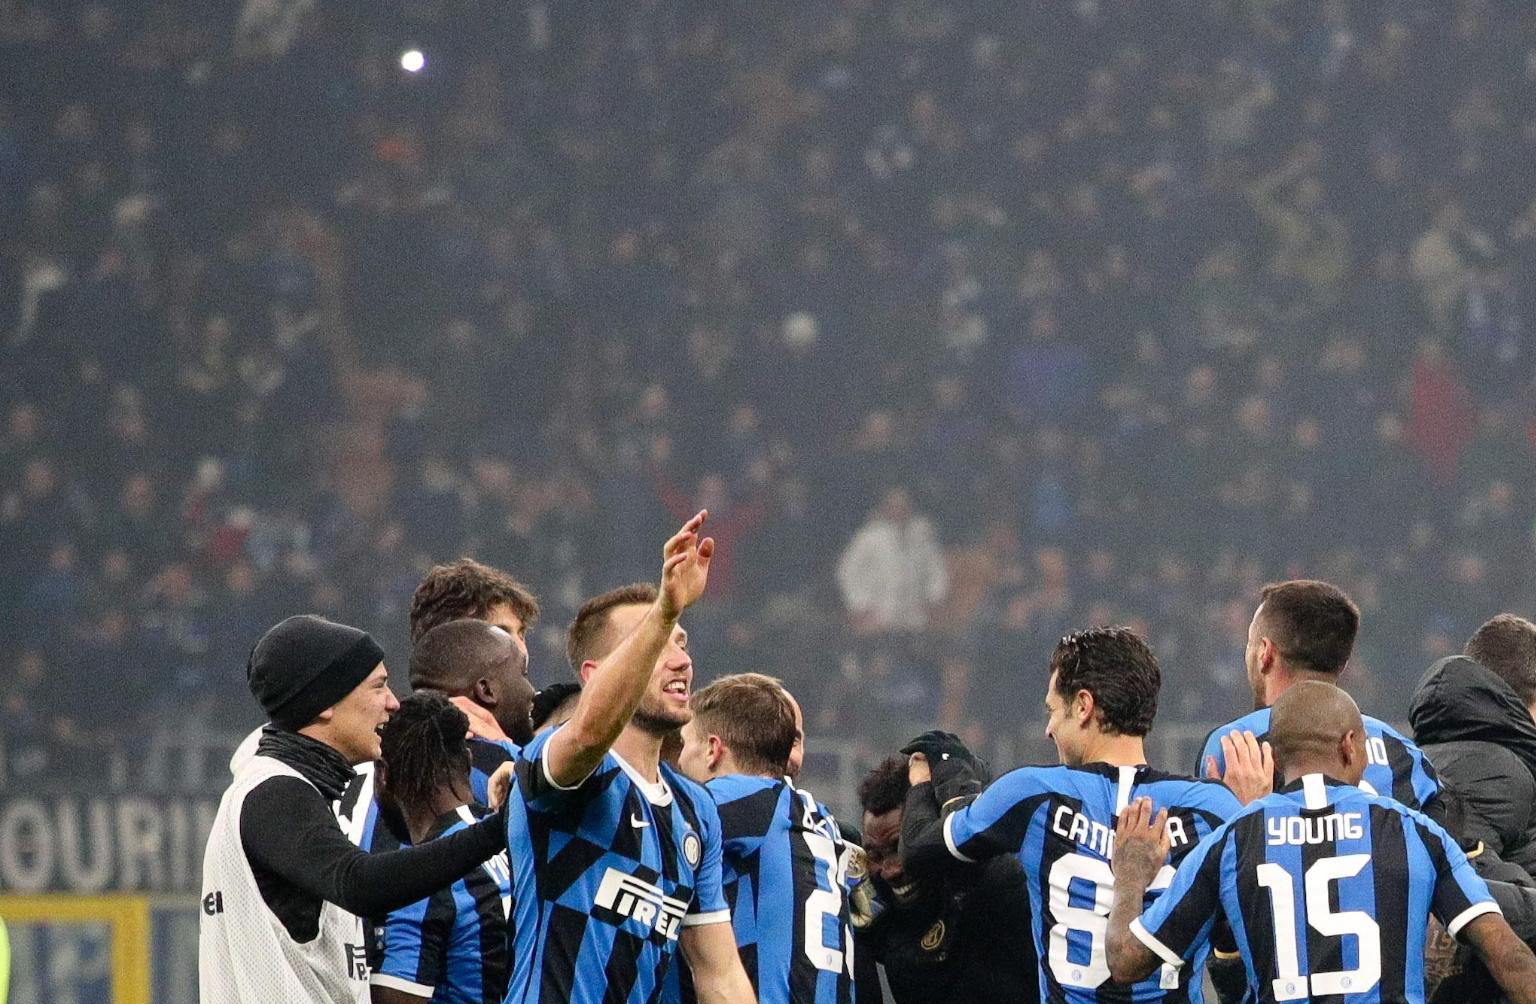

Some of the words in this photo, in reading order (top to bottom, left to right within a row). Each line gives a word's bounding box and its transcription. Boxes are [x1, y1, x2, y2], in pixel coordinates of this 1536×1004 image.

[1267, 812, 1364, 846] YOUNG
[802, 831, 854, 981] 2
[1256, 853, 1382, 1002] 15
